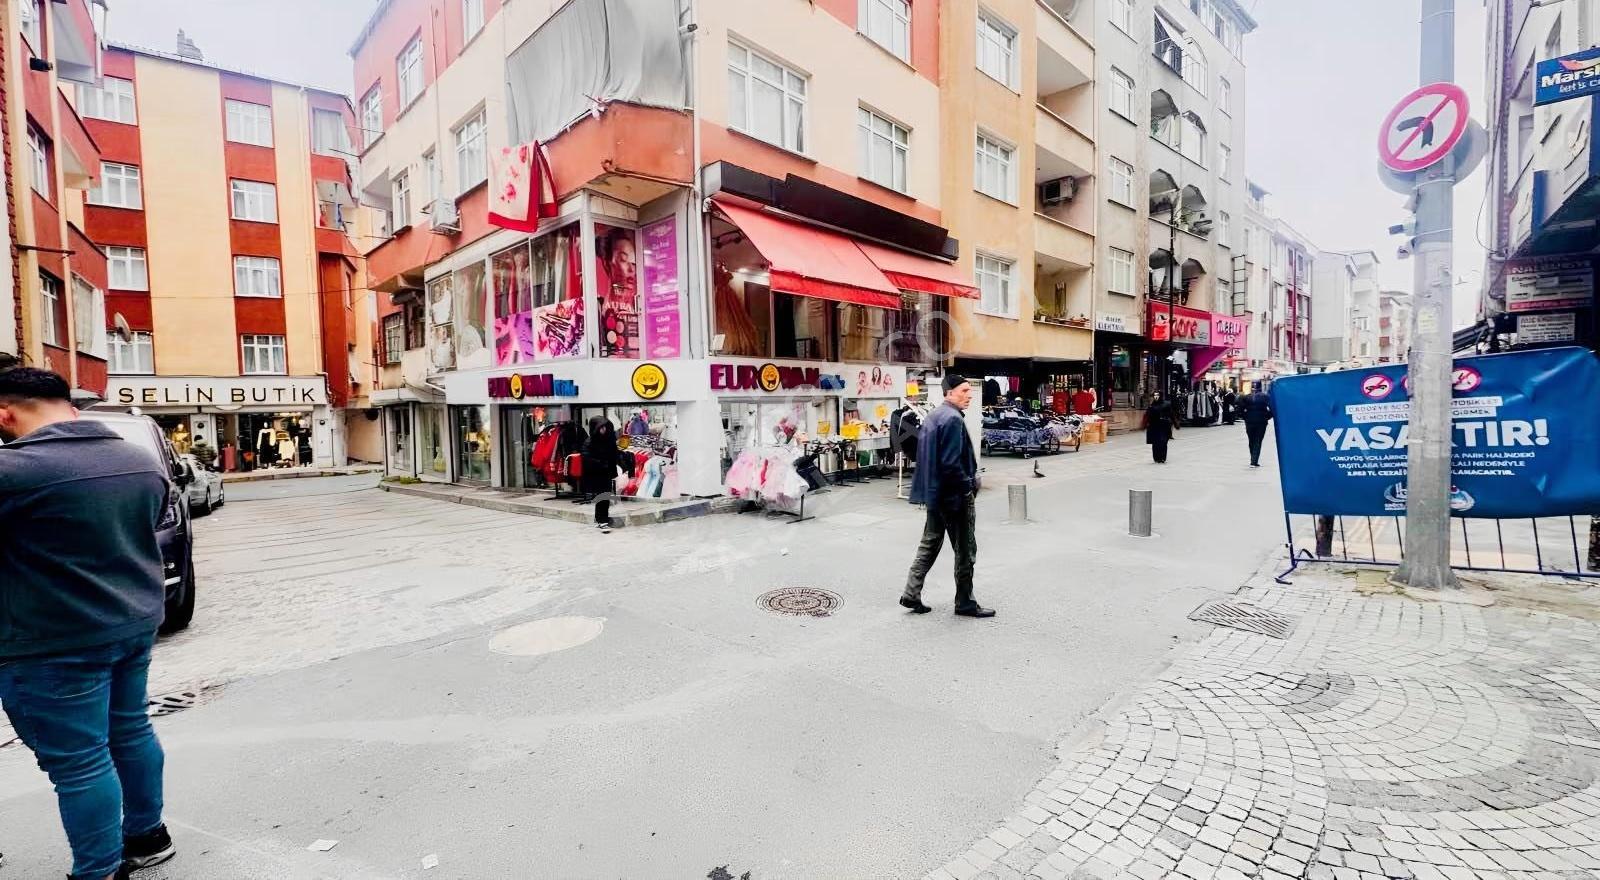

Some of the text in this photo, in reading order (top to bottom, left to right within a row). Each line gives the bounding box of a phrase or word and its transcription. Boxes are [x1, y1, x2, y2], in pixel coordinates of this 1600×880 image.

[118, 384, 316, 403] SELİN BUTİK
[1316, 419, 1550, 452] YASATIR!
